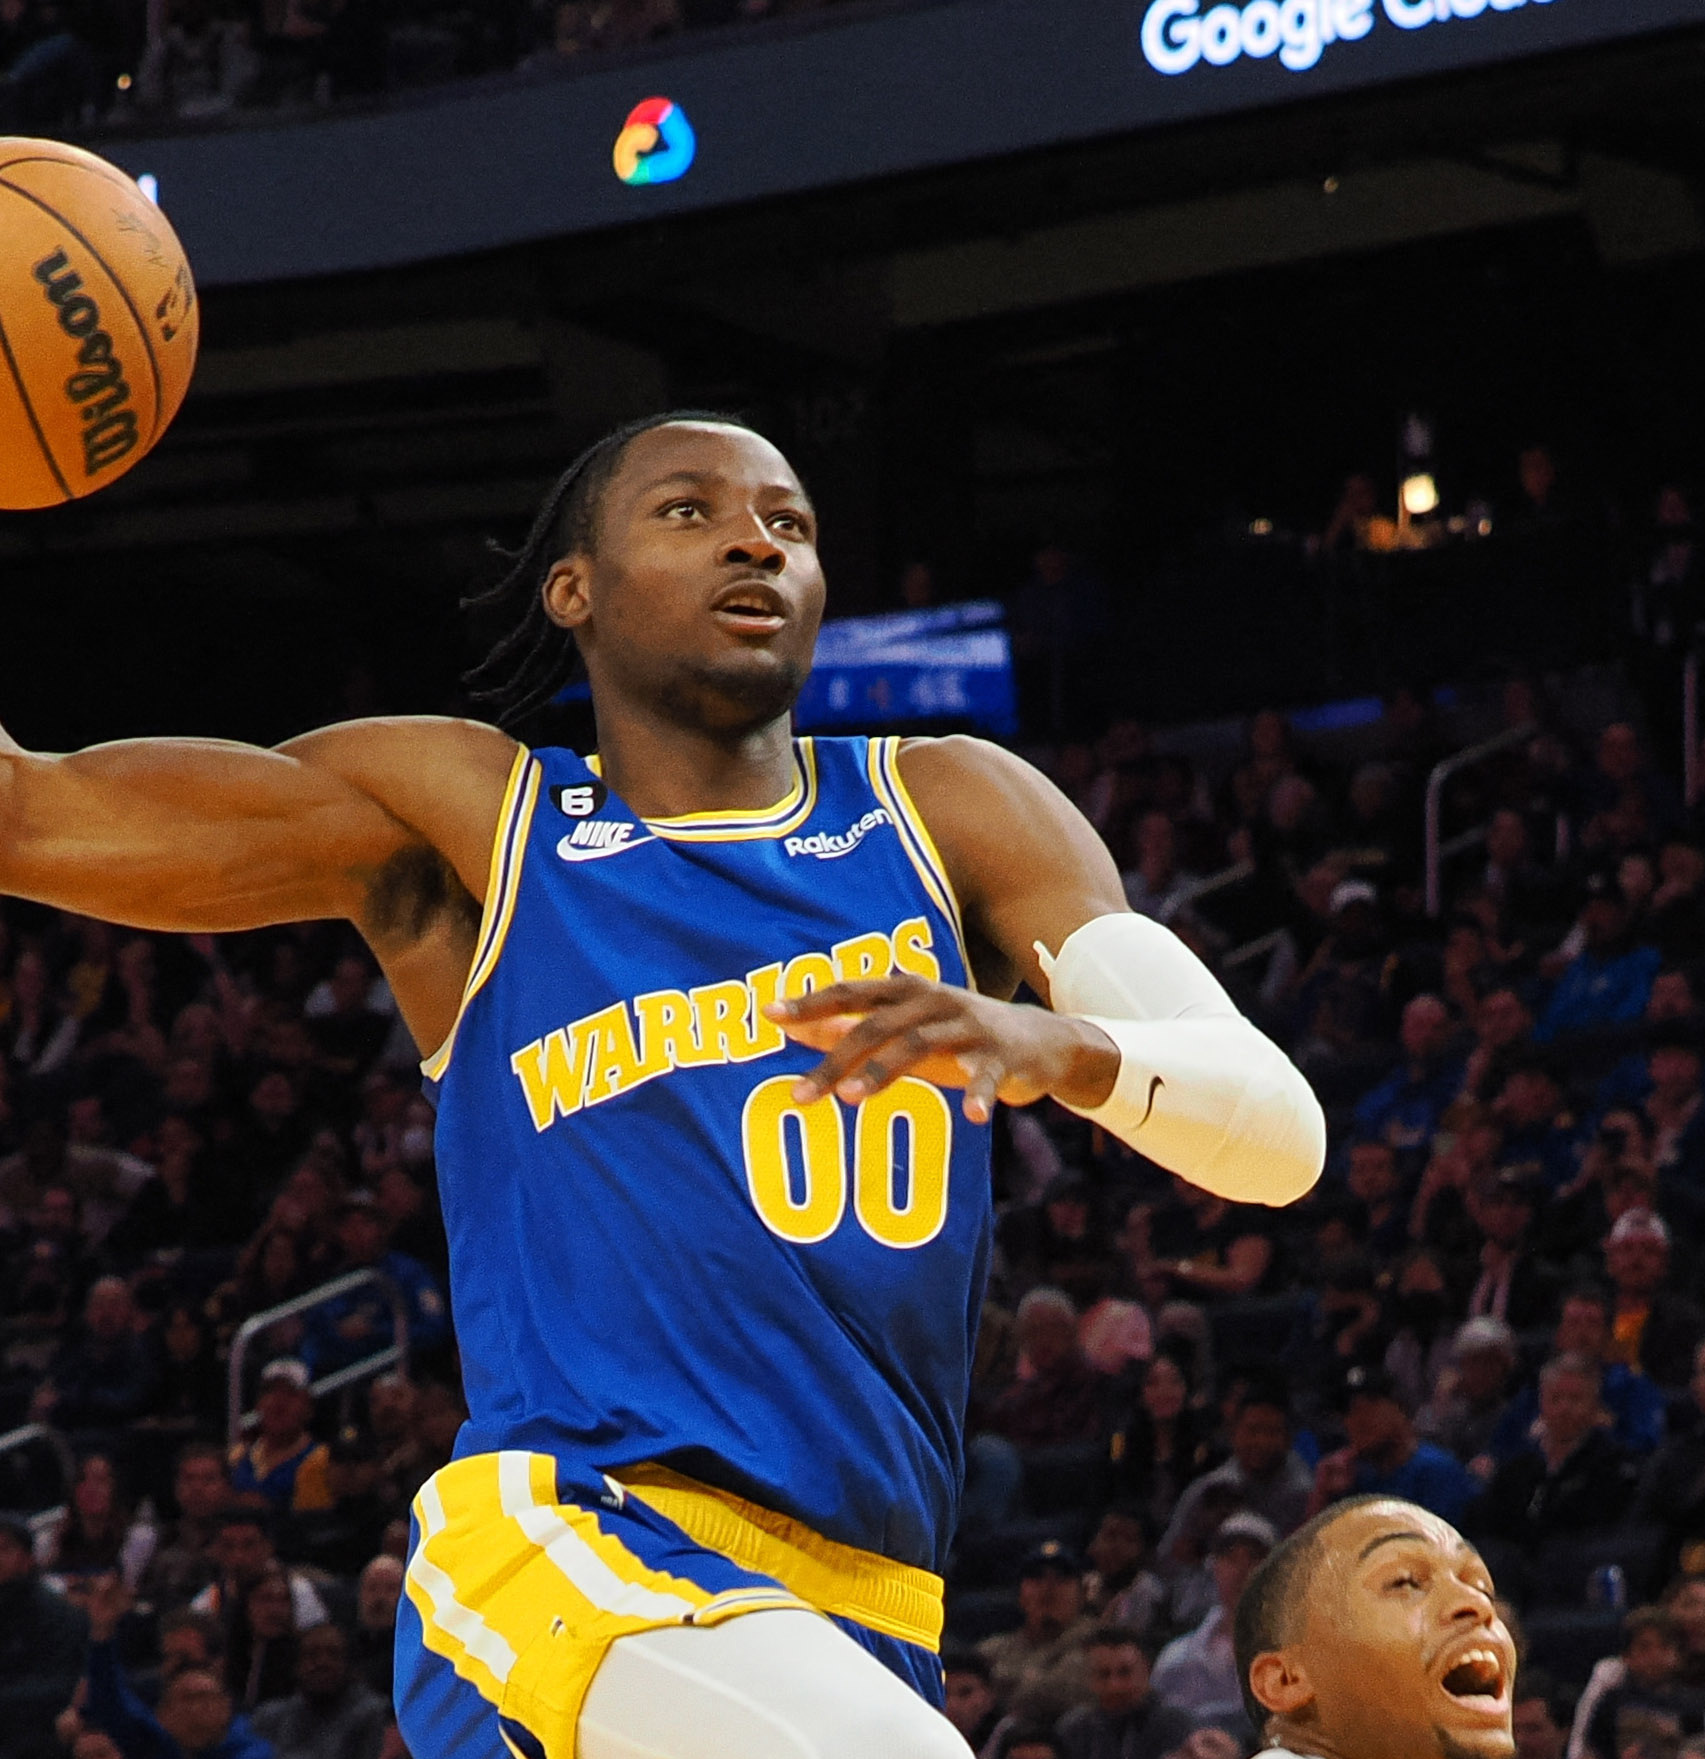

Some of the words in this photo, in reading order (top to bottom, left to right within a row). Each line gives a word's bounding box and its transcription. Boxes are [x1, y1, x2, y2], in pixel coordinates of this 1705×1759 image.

[31, 245, 139, 477] Wilson
[560, 786, 595, 817] 6
[569, 821, 634, 848] NIKE
[783, 807, 894, 858] Rakuten
[740, 1073, 953, 1250] 00
